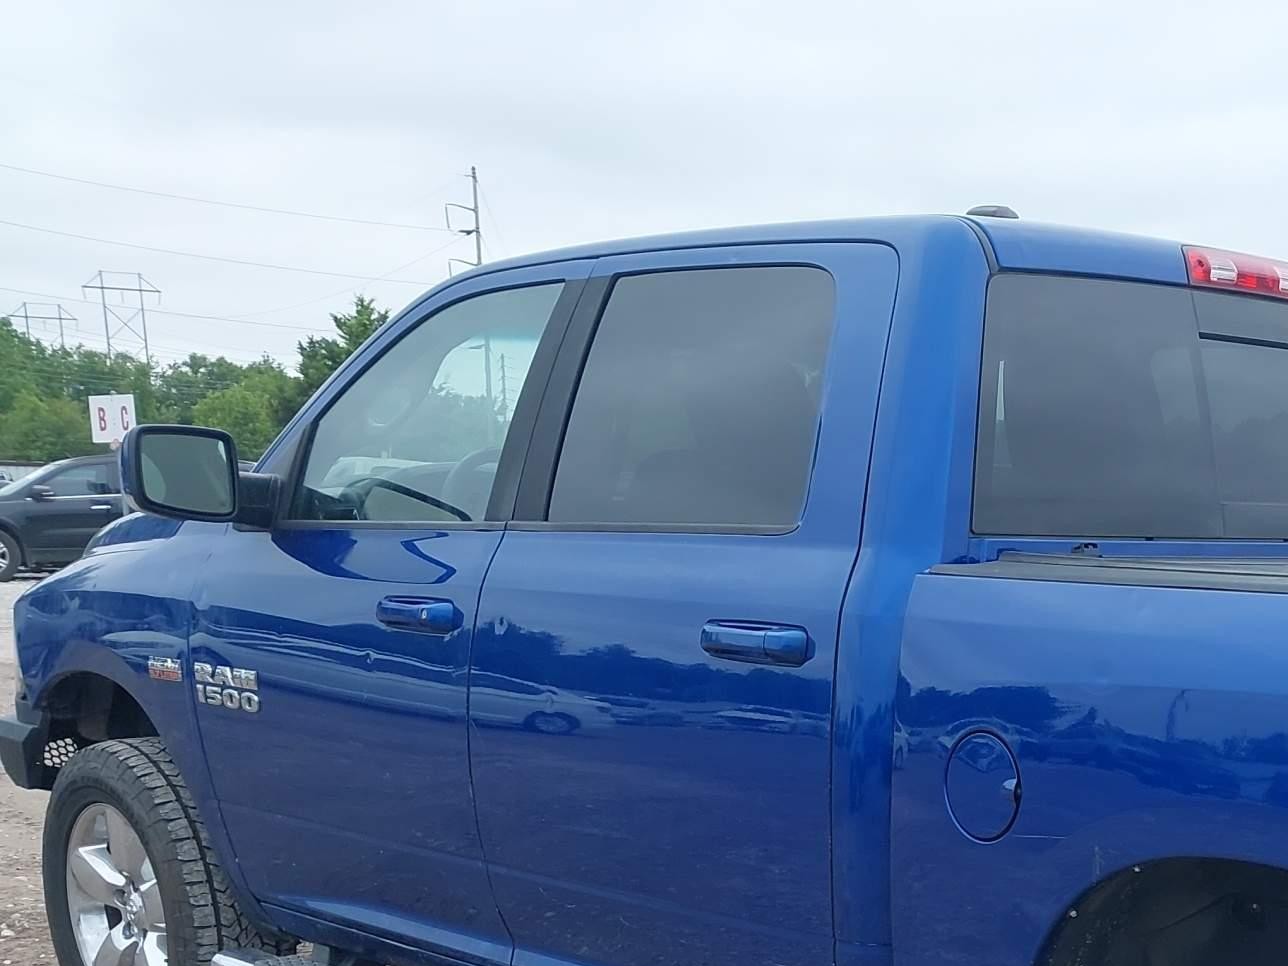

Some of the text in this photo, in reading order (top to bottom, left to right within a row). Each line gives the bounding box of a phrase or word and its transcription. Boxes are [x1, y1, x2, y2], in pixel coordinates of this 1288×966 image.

[97, 405, 129, 431] B C
[194, 661, 258, 690] RAM
[195, 683, 259, 713] 1500
